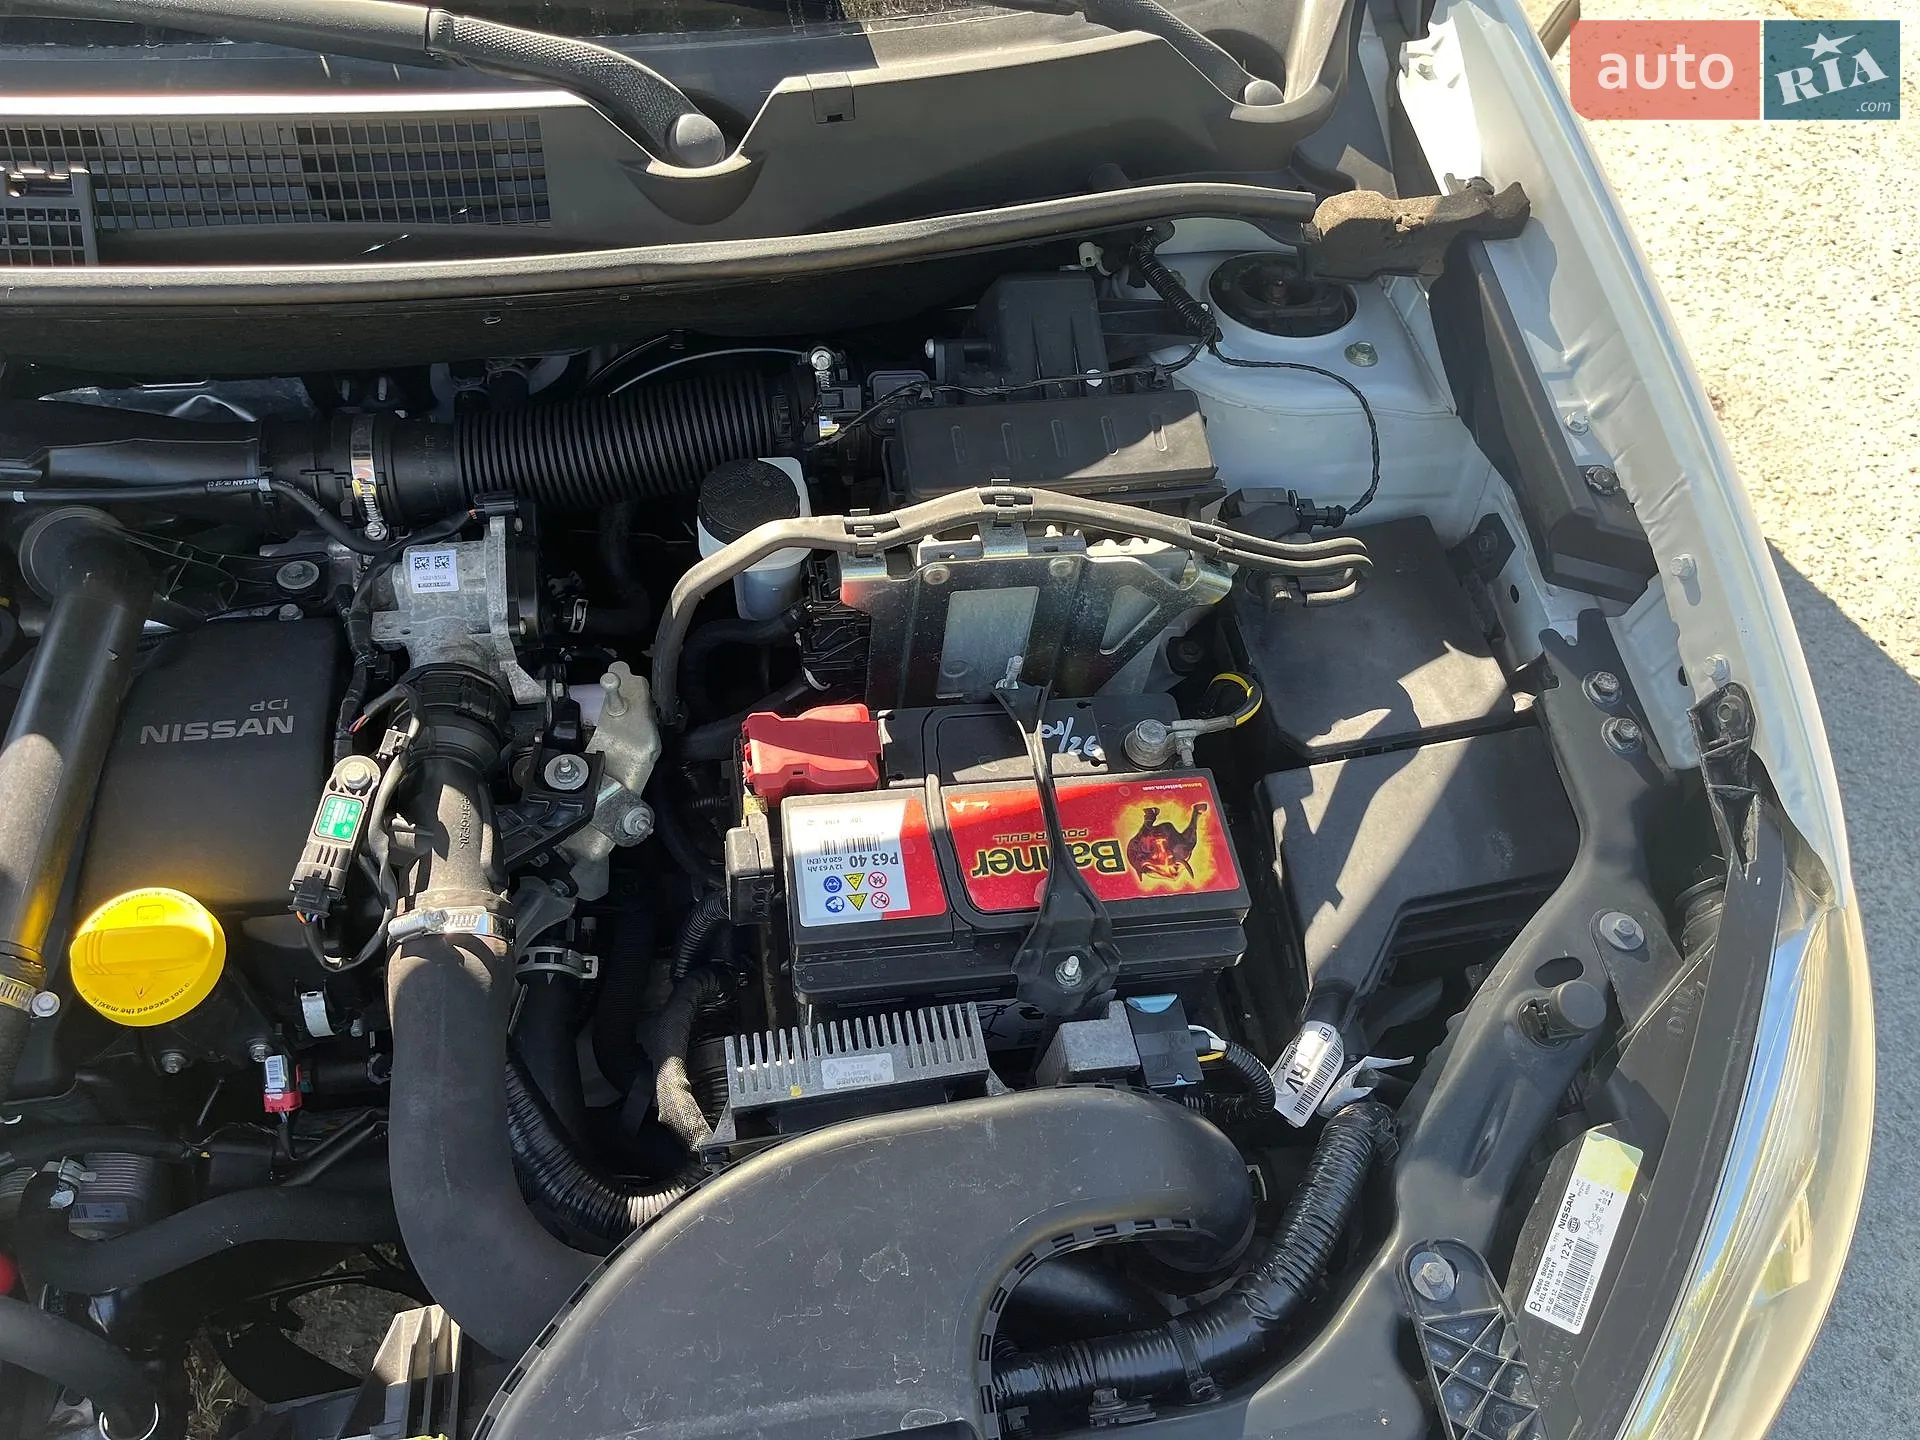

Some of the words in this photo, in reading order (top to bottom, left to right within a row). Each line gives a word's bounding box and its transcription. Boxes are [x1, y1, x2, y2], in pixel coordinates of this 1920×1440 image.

[249, 698, 288, 712] dCi
[140, 715, 294, 745] NISSAN
[993, 833, 1033, 844] BULL
[849, 855, 868, 868] 40
[872, 852, 899, 866] P63
[170, 988, 184, 1000] not
[98, 1001, 119, 1013] maxi
[120, 1007, 135, 1015] the
[137, 996, 170, 1014] exceed
[1558, 1192, 1576, 1230] NISSAN
[1529, 1301, 1542, 1312] B
